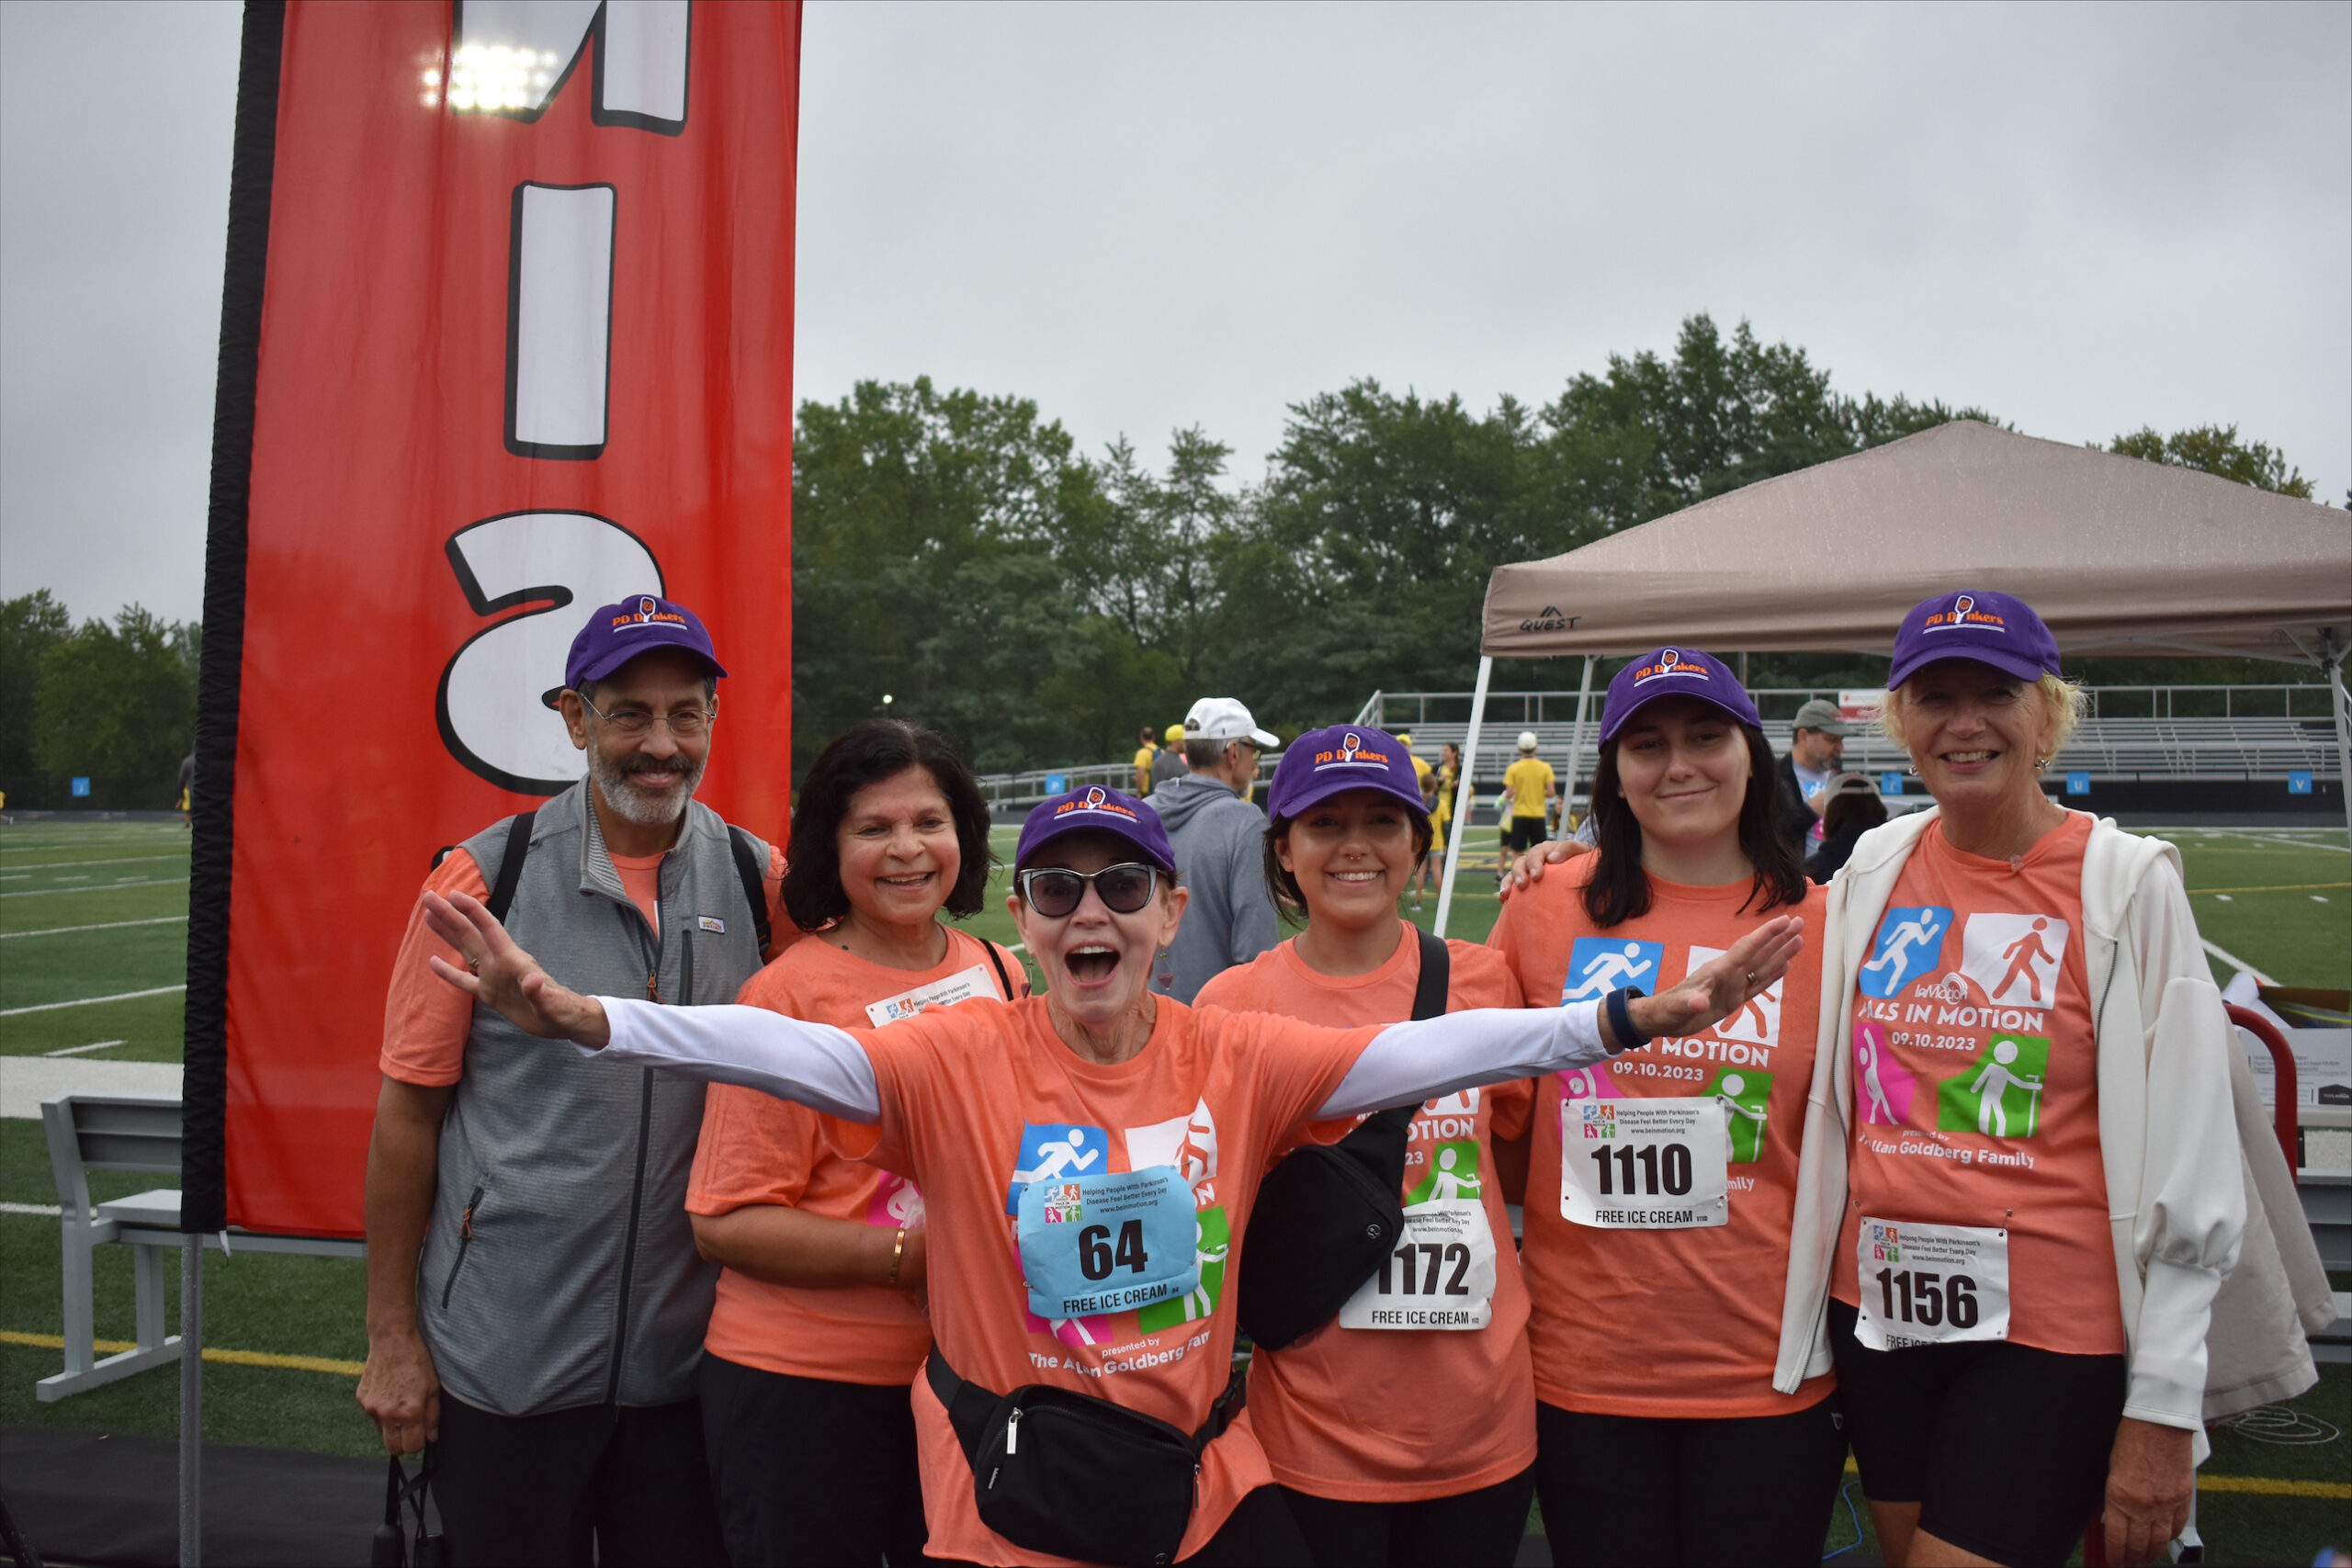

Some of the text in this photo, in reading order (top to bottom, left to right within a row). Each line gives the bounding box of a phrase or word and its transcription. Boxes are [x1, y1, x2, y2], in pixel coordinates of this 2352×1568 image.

[613, 615, 630, 626] PD
[1520, 615, 1582, 632] QUEST
[1926, 614, 1944, 626] PD
[1634, 667, 1652, 681] PD
[1315, 751, 1333, 765] PD
[1056, 801, 1075, 815] PD
[1905, 1004, 1933, 1023] IN
[1937, 1006, 2044, 1032] MOTION
[1892, 1032, 1975, 1051] 09.10.2023
[1661, 1036, 1770, 1068] MOTION
[1612, 1061, 1704, 1081] 09.10.2023
[1407, 1118, 1475, 1142] OTION
[1899, 1141, 1973, 1164] Goldberg
[1978, 1149, 2035, 1168] Family
[1590, 1143, 1692, 1195] 1110
[1082, 1177, 1169, 1196] Helping People With Parkinson's
[1726, 1177, 1756, 1191] mily
[1086, 1197, 1109, 1205] Disease
[1110, 1195, 1123, 1203] Feel
[1100, 1199, 1158, 1213] www.beinmotion.org
[1595, 1211, 1624, 1223] FREE
[1627, 1211, 1646, 1223] ICE
[1649, 1211, 1693, 1223] CREAM
[1078, 1219, 1148, 1281] 64
[1917, 1235, 1934, 1244] People
[1948, 1238, 1980, 1247] Parkinson's
[1378, 1243, 1471, 1295] 1172
[1063, 1296, 1097, 1314] FREE
[1101, 1293, 1122, 1309] ICE
[1124, 1283, 1168, 1304] CREAM
[1876, 1268, 1978, 1329] 1156
[1372, 1311, 1403, 1324] FREE
[1406, 1311, 1426, 1324] ICE
[1430, 1311, 1469, 1325] CREAM
[1102, 1337, 1159, 1359] presented by
[1886, 1334, 1909, 1348] FREE
[1028, 1352, 1058, 1370] The
[1103, 1347, 1184, 1374] Goldberg
